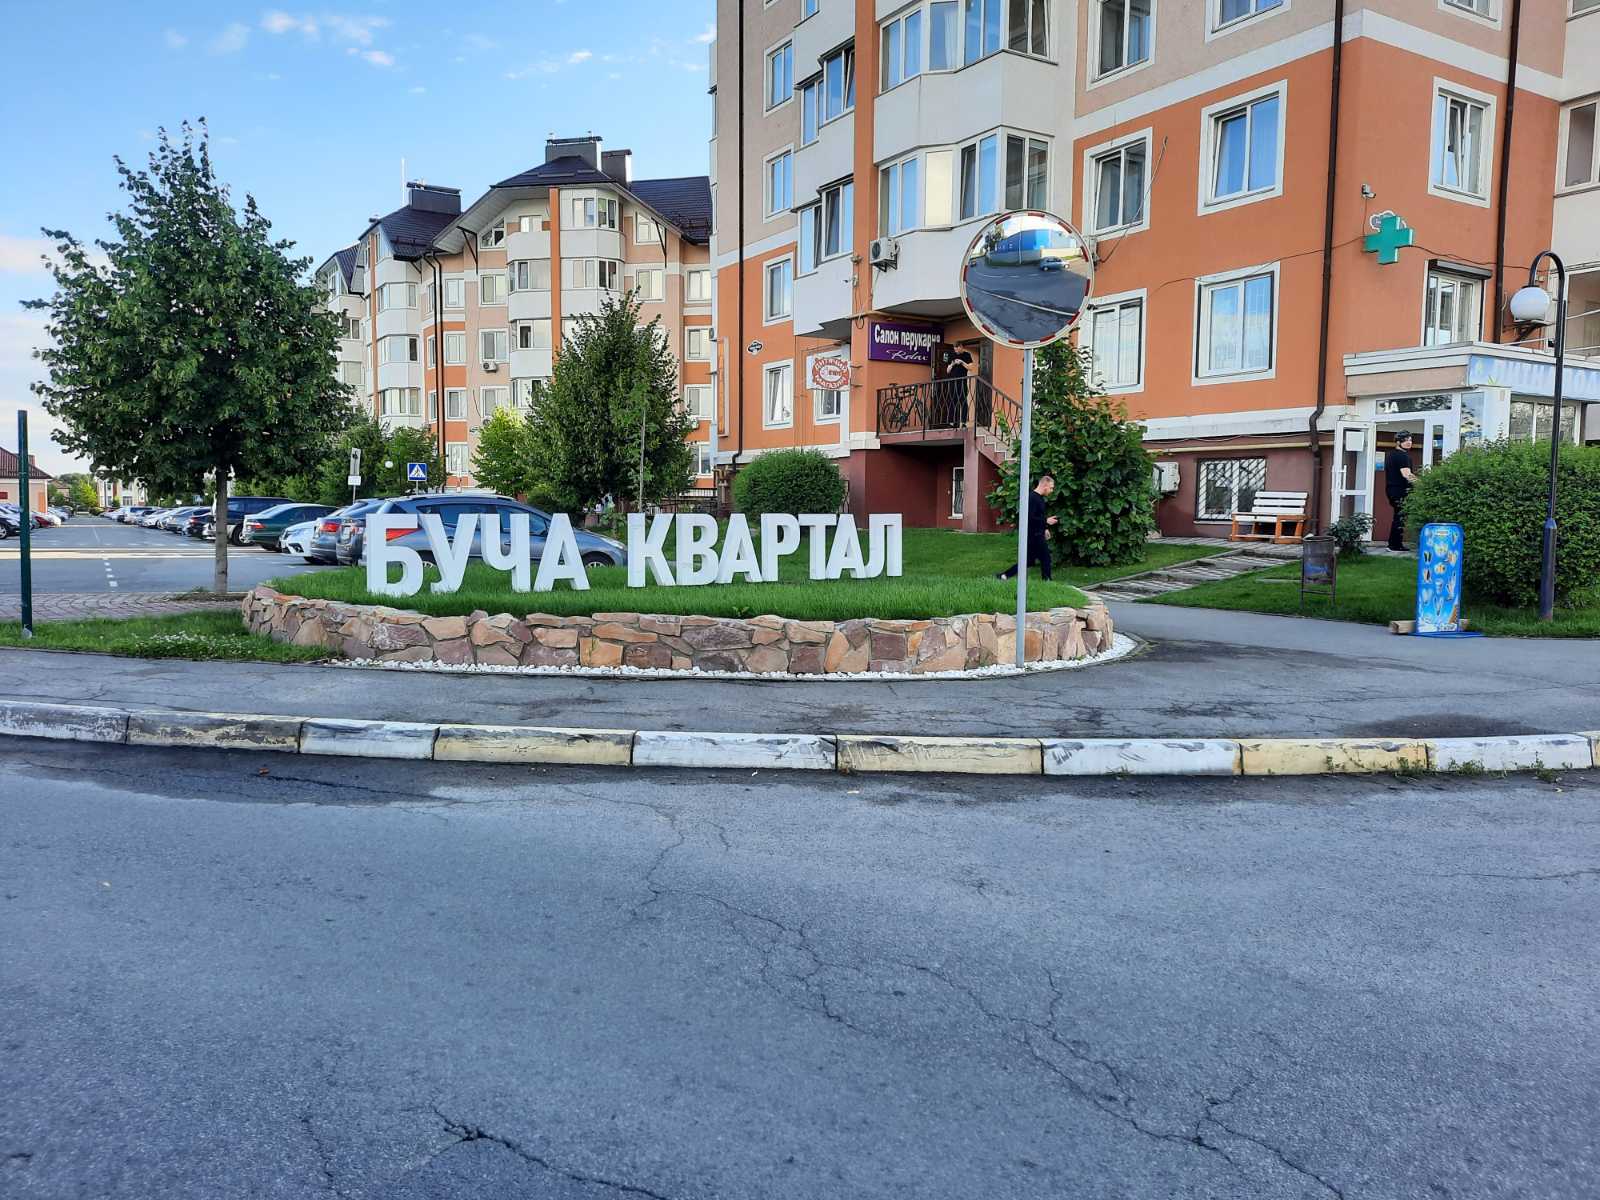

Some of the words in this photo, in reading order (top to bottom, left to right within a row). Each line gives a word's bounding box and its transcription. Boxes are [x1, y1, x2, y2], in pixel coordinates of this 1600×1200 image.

[874, 324, 899, 344] Салон
[366, 512, 590, 597] БУЧА
[627, 512, 903, 588] КВАРТАЛ
